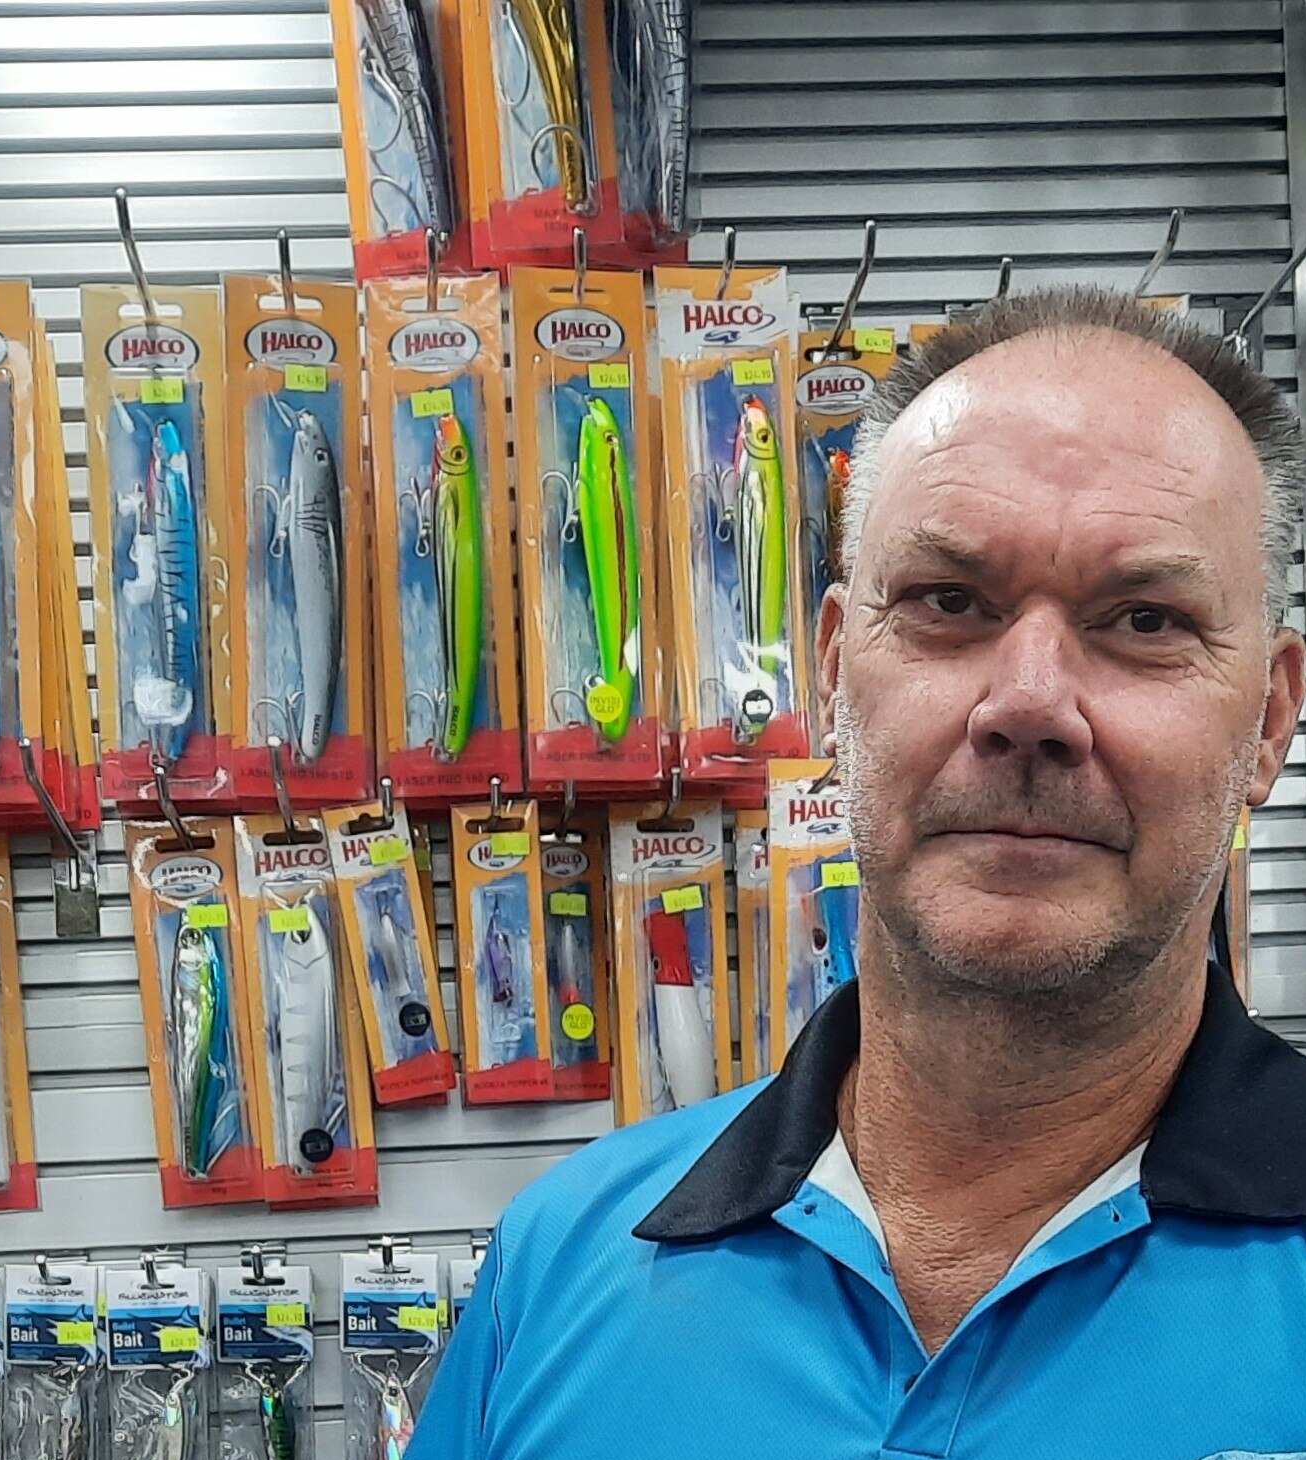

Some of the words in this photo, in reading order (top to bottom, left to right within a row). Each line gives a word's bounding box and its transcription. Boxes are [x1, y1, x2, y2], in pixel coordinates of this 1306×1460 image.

[683, 305, 764, 331] HALCO
[261, 332, 323, 354] HALCO
[404, 332, 466, 356] HALCO
[551, 321, 612, 344] HALCO
[121, 338, 185, 361] HALCO
[807, 376, 866, 400] HALCO
[449, 706, 457, 736] HALCO
[789, 800, 843, 825] HALC
[632, 837, 705, 861] HALCO
[255, 849, 328, 876] HALCO
[545, 852, 581, 870] HALCO
[567, 1020, 590, 1030] GLO
[11, 1328, 39, 1342] Bait
[224, 1327, 253, 1341] Bait
[348, 1316, 377, 1331] Bait
[113, 1333, 143, 1347] Bait
